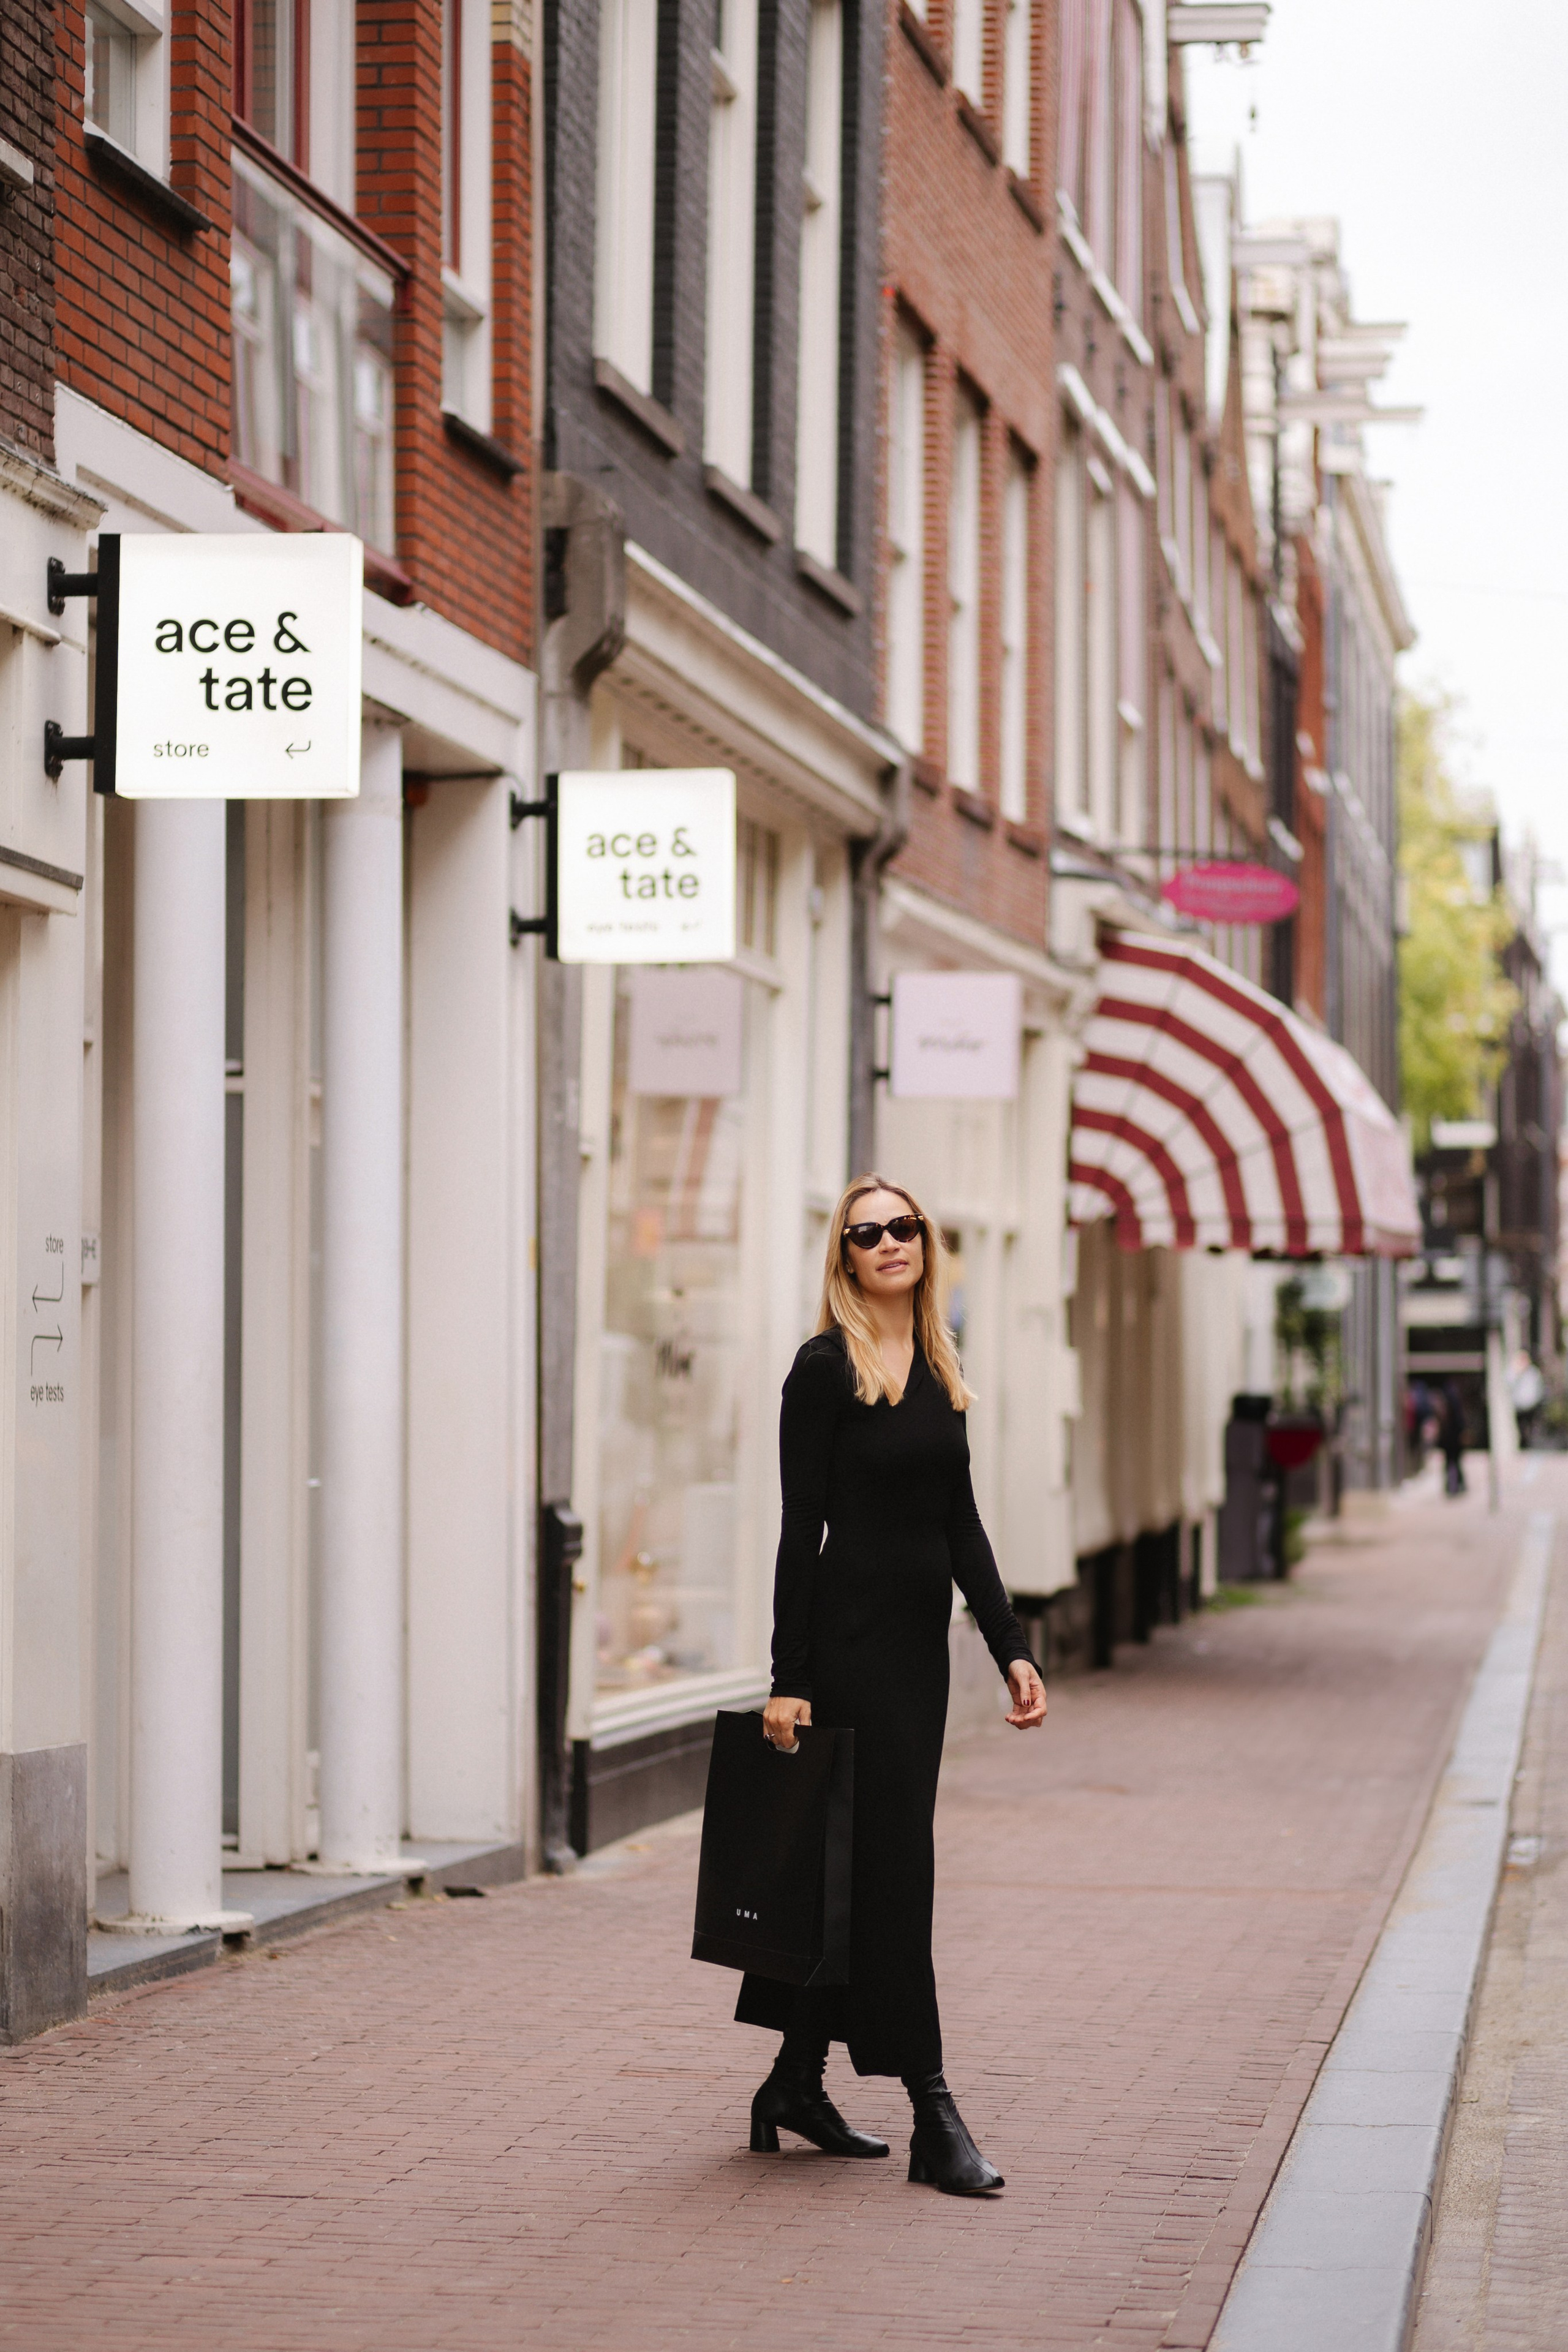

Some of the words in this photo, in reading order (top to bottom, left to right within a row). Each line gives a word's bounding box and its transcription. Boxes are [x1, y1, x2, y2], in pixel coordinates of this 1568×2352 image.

[154, 619, 256, 654] ace
[273, 611, 312, 654] &
[199, 667, 312, 712] tate
[153, 740, 209, 758] store
[586, 833, 658, 858] ace
[671, 827, 697, 858] &
[620, 868, 699, 899] tate
[45, 1234, 64, 1254] store
[31, 1384, 43, 1407] eye
[45, 1382, 64, 1402] tests
[737, 1908, 758, 1920] UMA
